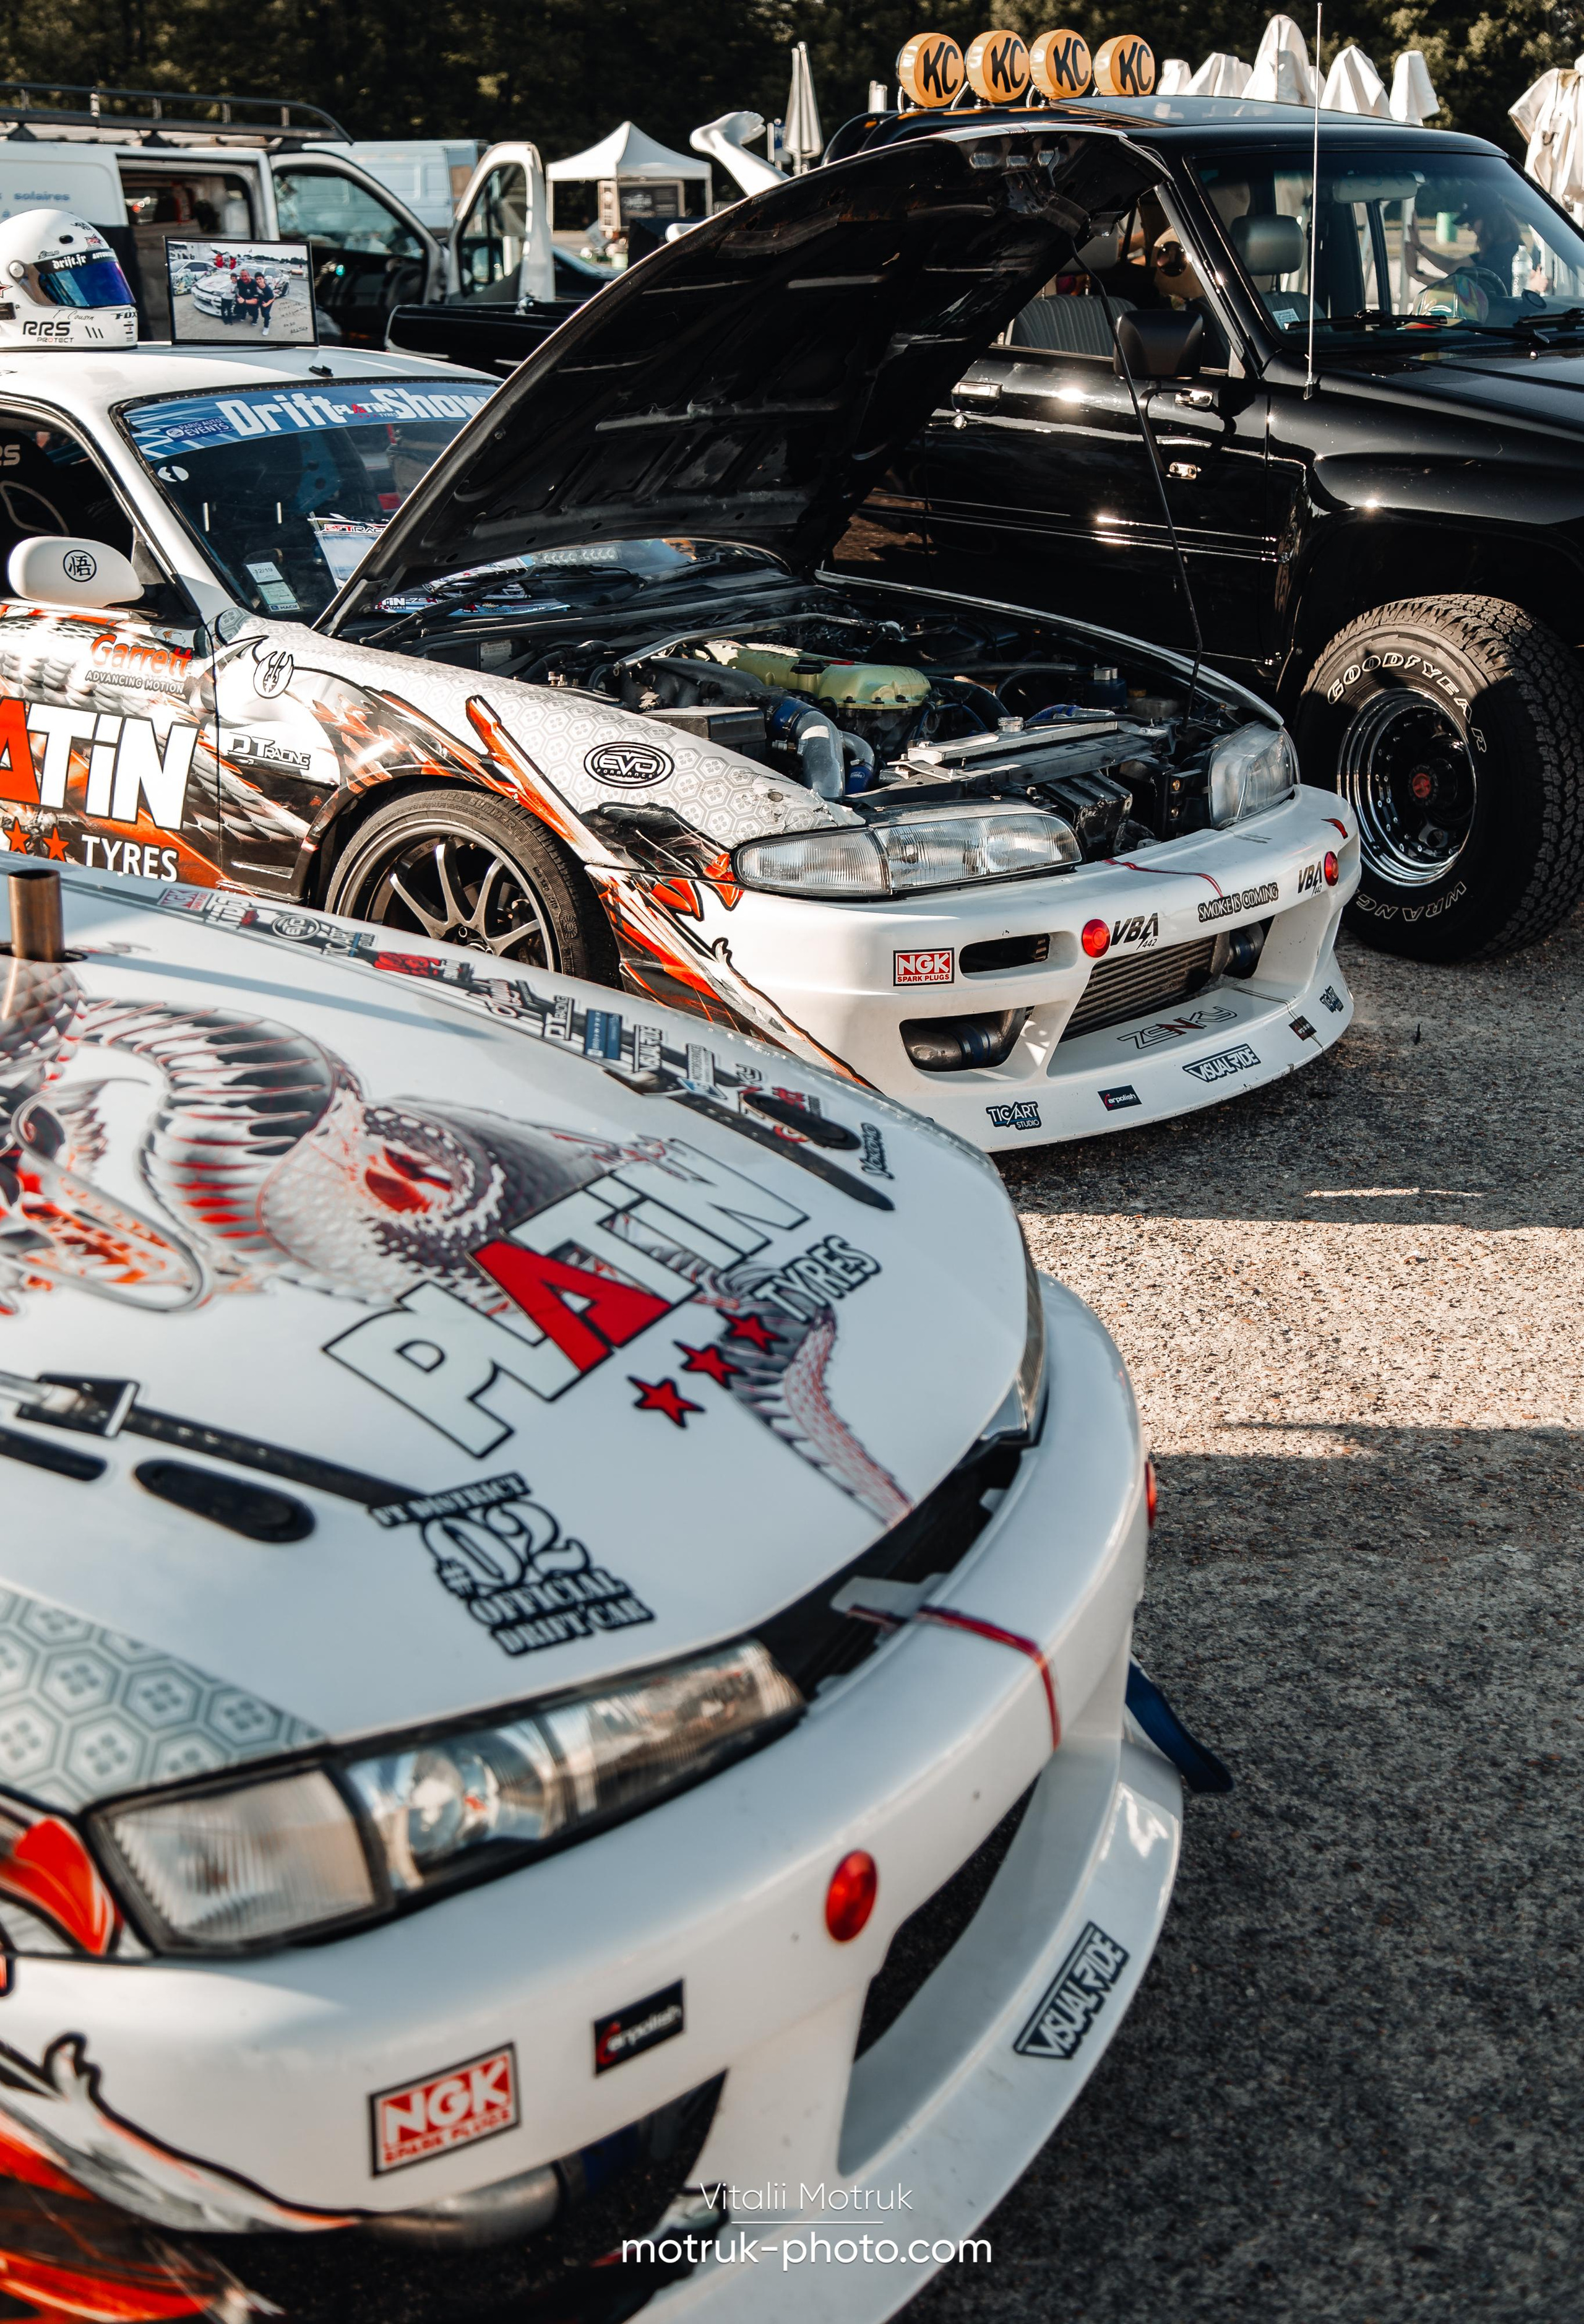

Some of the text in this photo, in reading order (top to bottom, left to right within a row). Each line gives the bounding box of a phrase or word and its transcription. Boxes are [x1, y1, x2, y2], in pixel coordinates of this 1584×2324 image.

[923, 41, 958, 98] KC
[991, 37, 1025, 93] KC
[1053, 37, 1087, 91] KC
[1119, 42, 1152, 95] KC
[14, 191, 70, 201] solaires
[23, 321, 71, 336] RRS
[179, 418, 222, 431] PARIS AUTO
[184, 421, 230, 437] EVENTS
[215, 393, 348, 436] Drift
[69, 555, 91, 576] 悟
[91, 634, 193, 678] Garrett
[85, 670, 185, 694] ADVANCING MOTION
[1327, 652, 1487, 753] GOODYEAR
[598, 754, 658, 775] EVO
[82, 834, 178, 883] TYRES
[1298, 861, 1323, 894] VBA
[162, 889, 199, 909] NGK
[1199, 883, 1278, 921] SMOKE IS COMING
[1355, 881, 1466, 922] WRANG
[1111, 913, 1159, 947] VBA
[1142, 938, 1158, 948] 442
[897, 974, 950, 983] SPARK PLUGS
[898, 954, 950, 975] NGK
[1117, 1006, 1238, 1049] ZENKY
[1017, 1119, 1040, 1129] STUDIO
[747, 1235, 884, 1324] TYRES
[468, 1570, 632, 1627] OFFICIAL
[491, 1597, 655, 1655] DRIFT CAR
[384, 2054, 510, 2145] NGK
[384, 2109, 512, 2164] SPARK PLUGS
